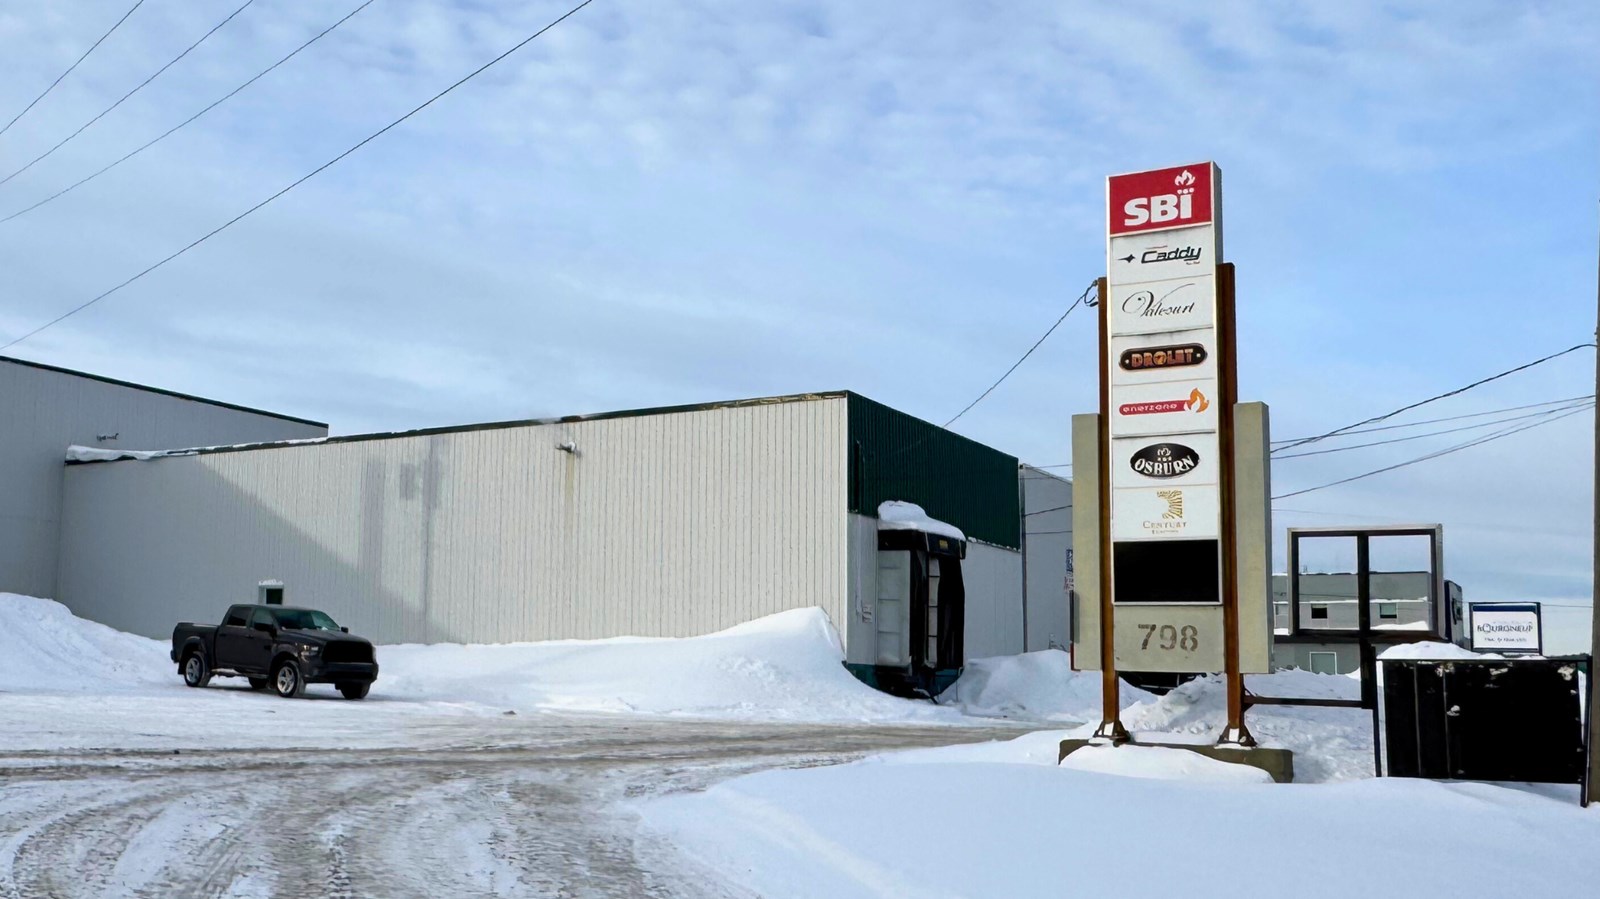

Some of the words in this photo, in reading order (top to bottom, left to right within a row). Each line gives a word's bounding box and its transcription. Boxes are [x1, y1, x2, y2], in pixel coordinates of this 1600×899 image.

[1141, 246, 1201, 264] Caddy
[1131, 348, 1194, 368] DROLET
[1134, 455, 1195, 475] OSBURN
[1138, 624, 1199, 652] 798
